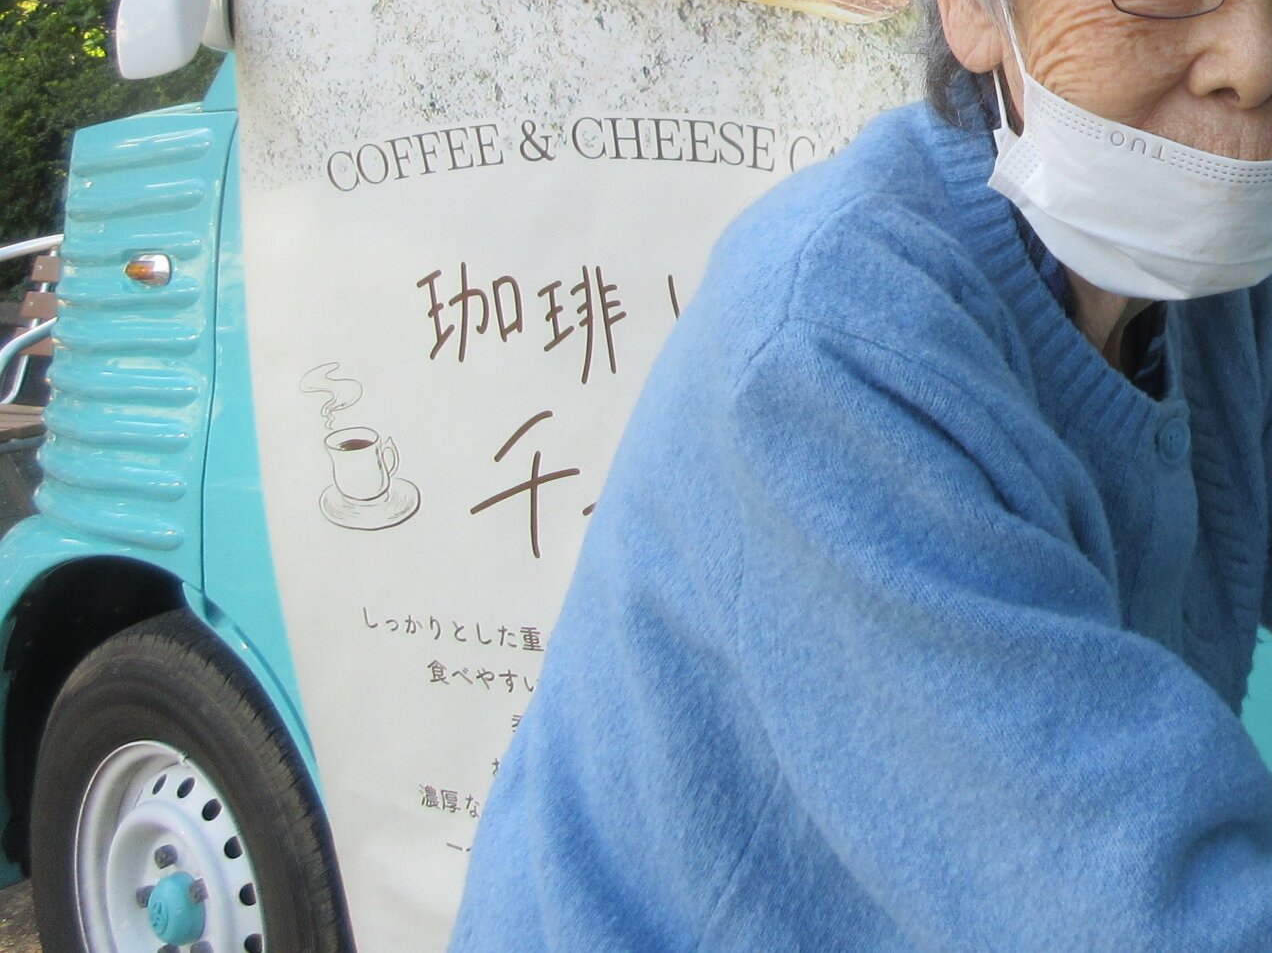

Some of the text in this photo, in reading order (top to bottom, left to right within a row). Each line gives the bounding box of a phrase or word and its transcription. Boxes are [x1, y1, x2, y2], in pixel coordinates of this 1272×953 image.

[326, 123, 504, 192] COFFEE
[519, 119, 556, 163] &
[571, 116, 776, 173] CHEESE
[470, 410, 599, 559] チ
[362, 606, 545, 653] しっかりとした重
[418, 783, 481, 819] 濃厚な
